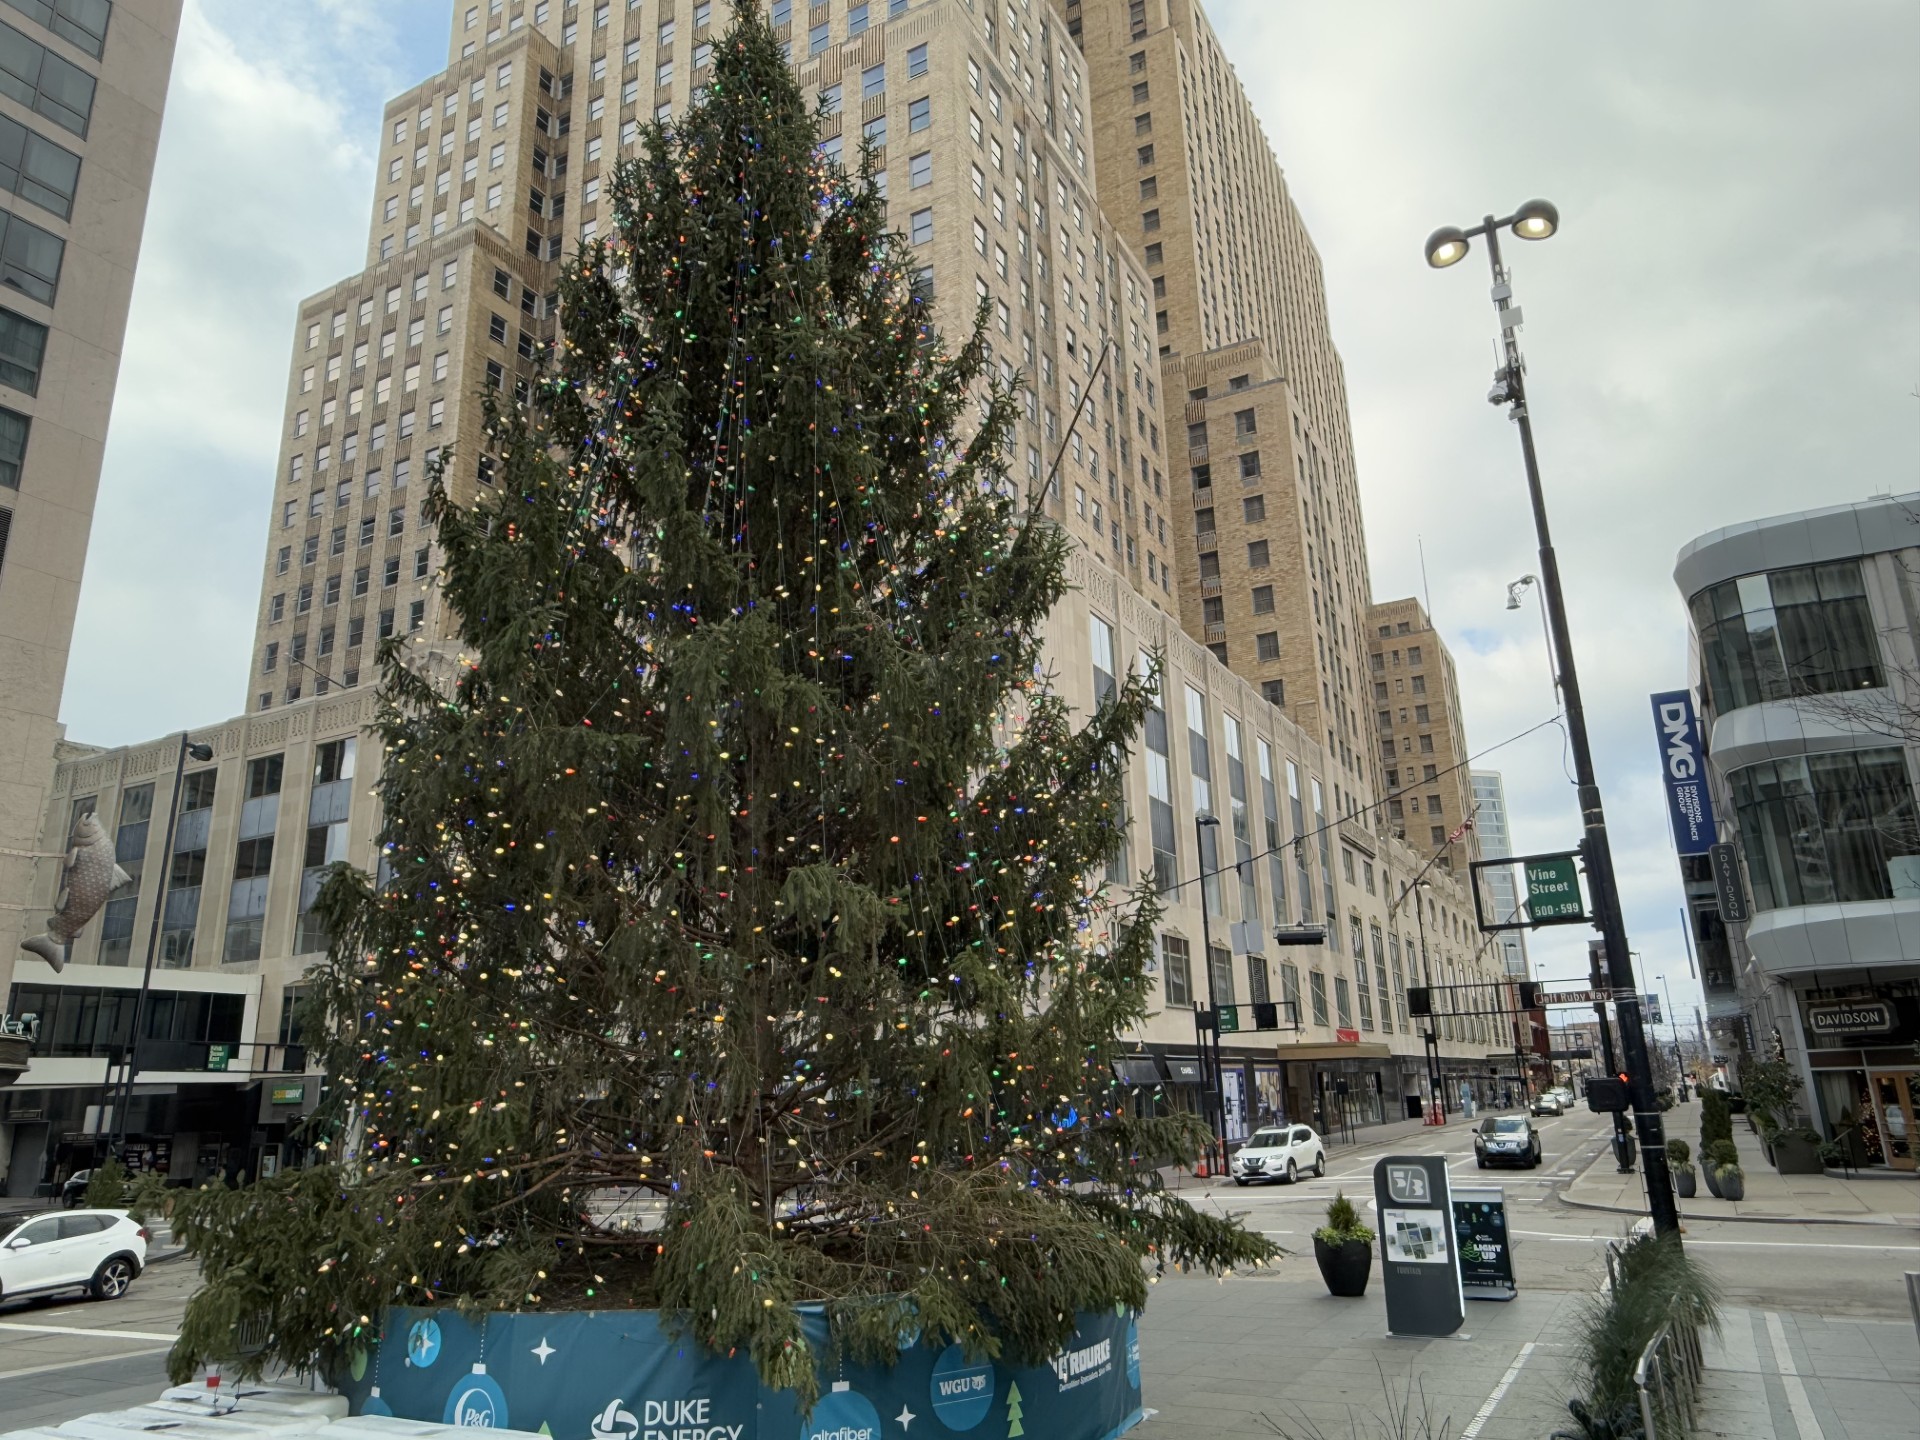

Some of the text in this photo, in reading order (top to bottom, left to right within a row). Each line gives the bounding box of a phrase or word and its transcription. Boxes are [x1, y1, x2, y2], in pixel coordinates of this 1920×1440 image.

[1676, 786, 1687, 814] GROUP
[1690, 785, 1703, 823] DIVISIONS
[1683, 786, 1699, 841] MAINTENANCE
[1528, 869, 1557, 881] Vine
[1530, 881, 1569, 895] Street
[1720, 854, 1740, 918] DAVIDSON
[1538, 990, 1608, 1004] Jeff Ruby Way
[1817, 1011, 1880, 1026] DAVIDSON
[1473, 1243, 1502, 1253] LIGHT
[1481, 1251, 1496, 1260] UP
[938, 1377, 970, 1396] WGU
[463, 1408, 491, 1428] P&G
[644, 1398, 711, 1426] DUKE
[810, 1426, 873, 1440] altafiber
